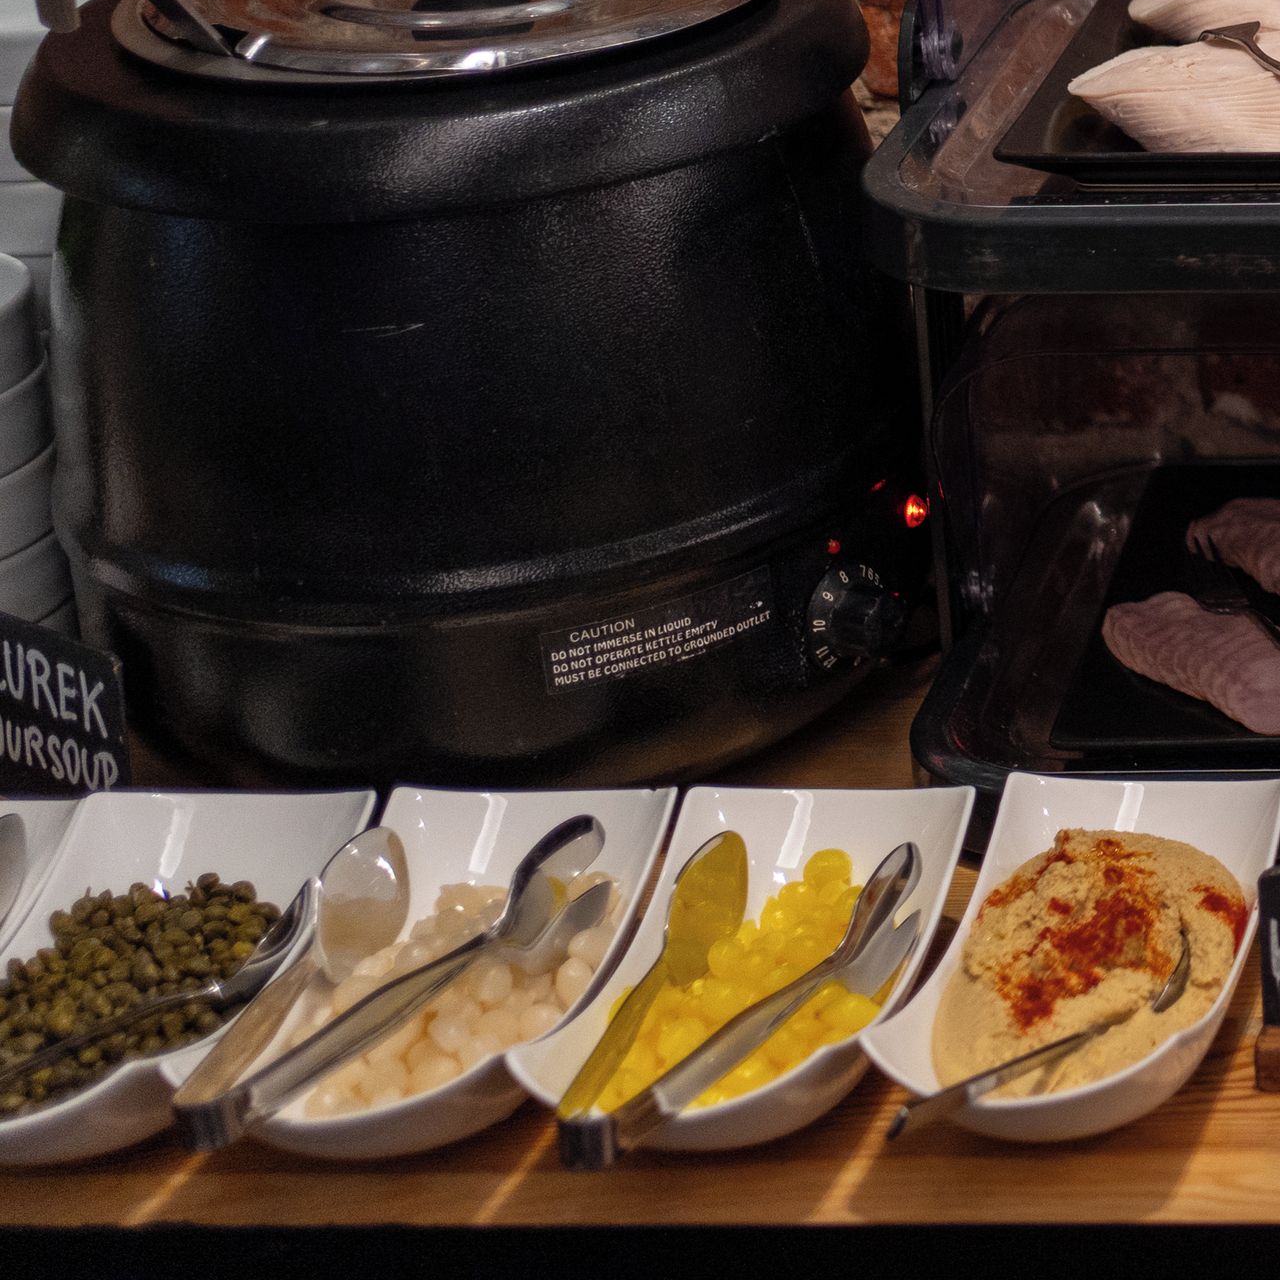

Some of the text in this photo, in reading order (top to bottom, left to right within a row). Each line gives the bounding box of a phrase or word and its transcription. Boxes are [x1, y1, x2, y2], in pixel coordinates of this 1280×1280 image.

[839, 570, 849, 584] 8
[822, 591, 834, 602] 9
[551, 617, 692, 661] DO NOT IMMERSE IN LIQUID
[569, 617, 635, 643] CAUTION
[812, 619, 826, 632] 10
[553, 620, 718, 673] DO NOT OPERATE KETTLE EMPTY
[555, 610, 771, 686] MUST BE CONNECTED TO GROUNDED OUTLET
[0, 639, 109, 739] UREK
